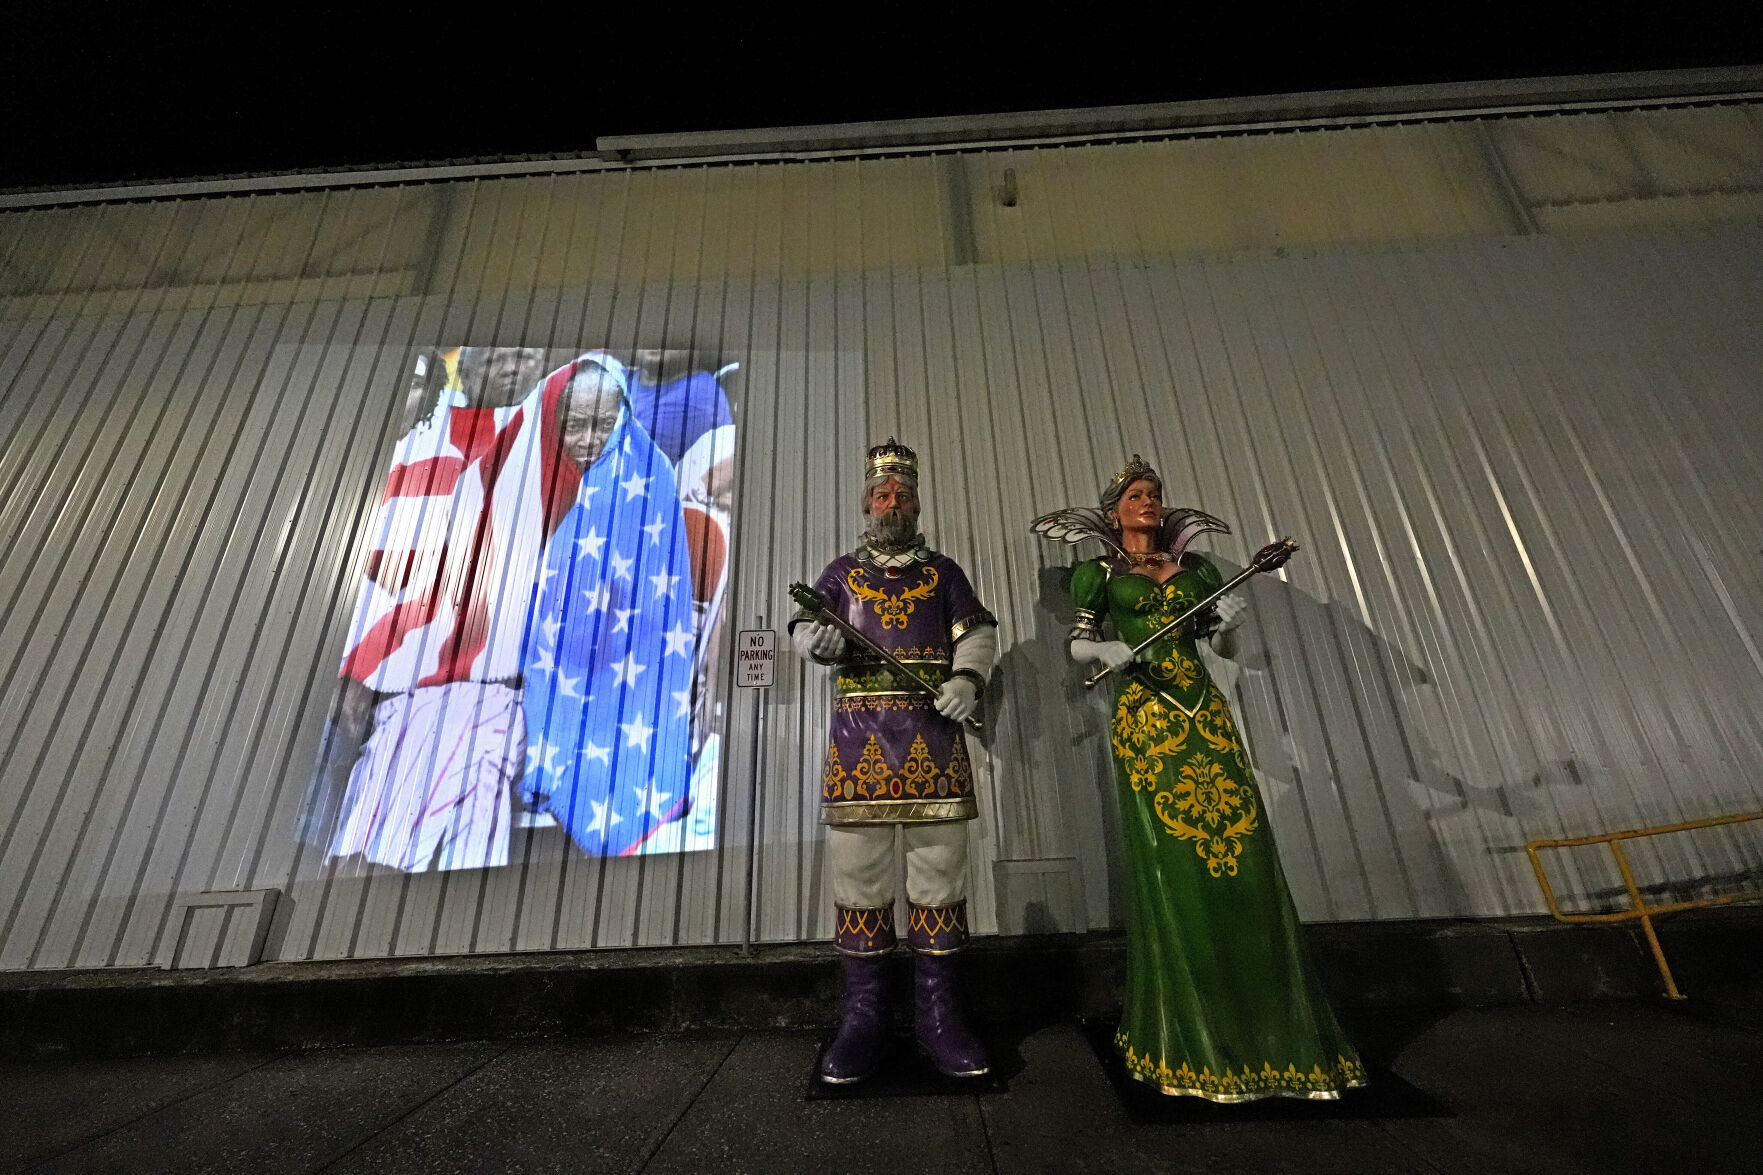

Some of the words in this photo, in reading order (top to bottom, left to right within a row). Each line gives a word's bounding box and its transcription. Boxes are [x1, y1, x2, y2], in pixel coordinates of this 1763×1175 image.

[750, 636, 764, 647] NO
[740, 650, 773, 661] PARKING
[749, 663, 763, 671] ANY
[747, 673, 765, 681] TIME
